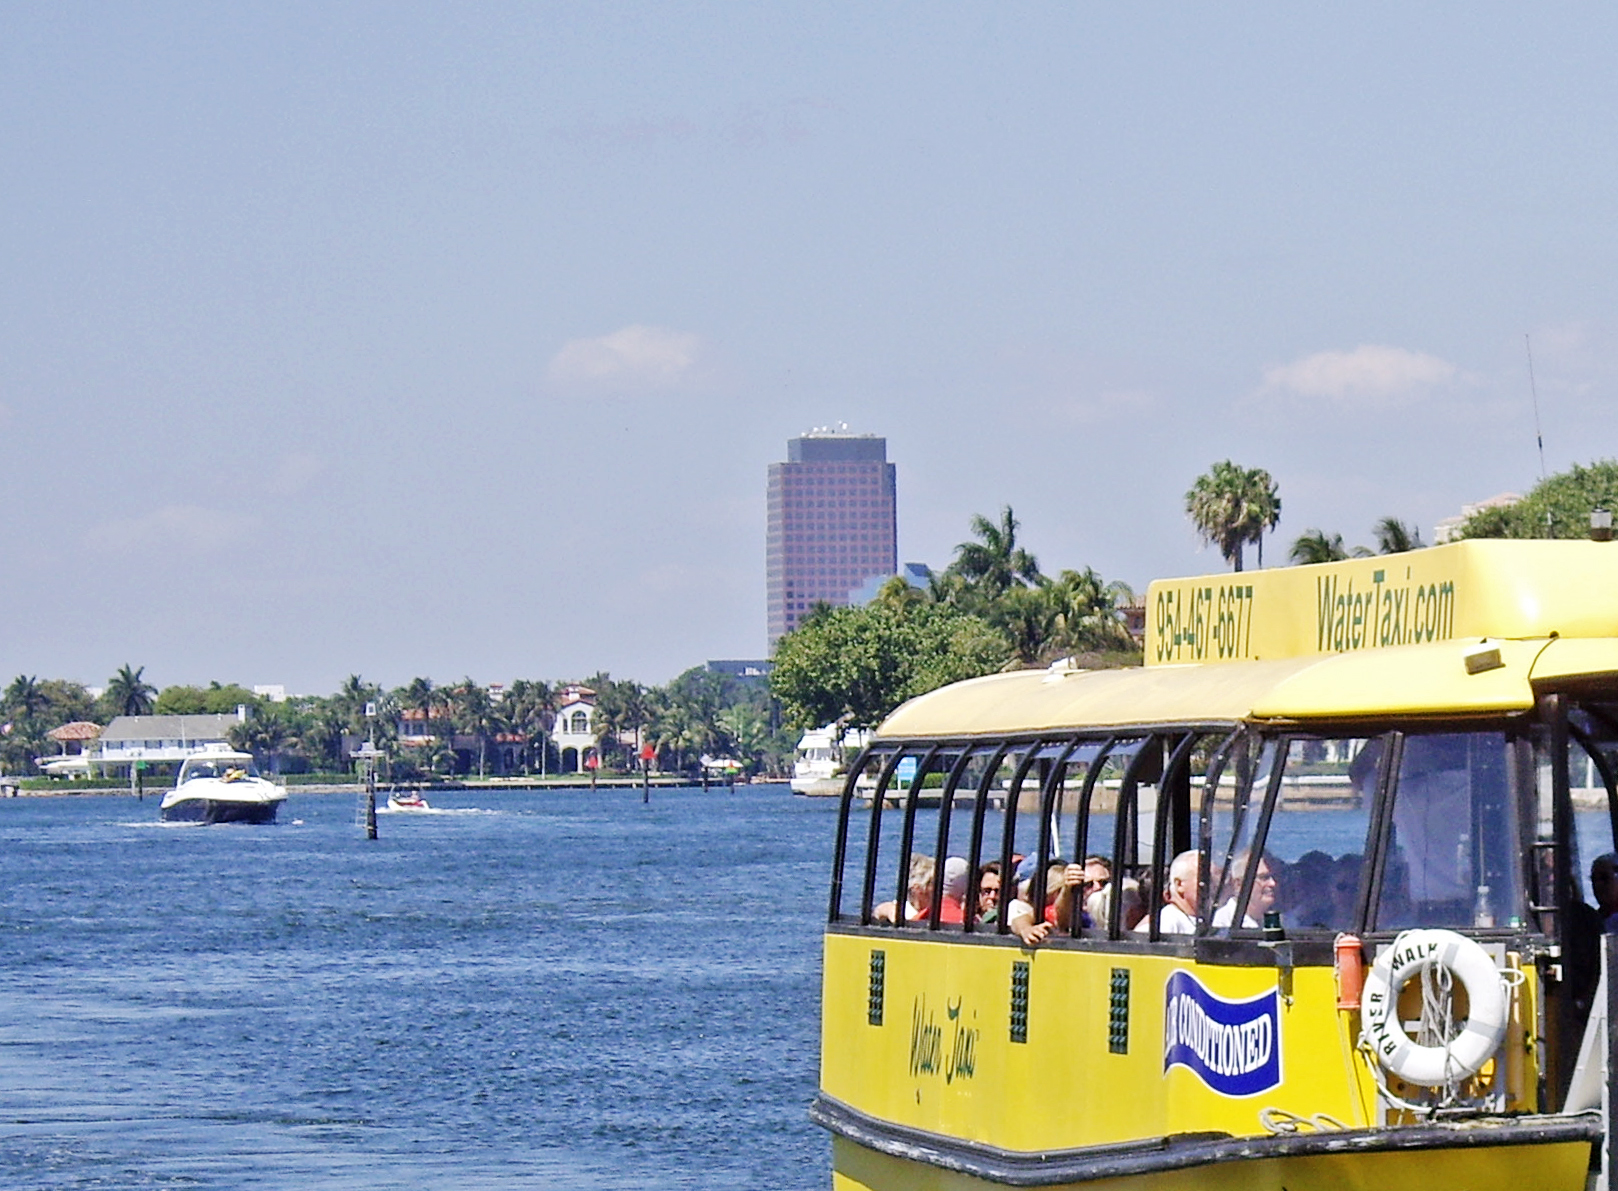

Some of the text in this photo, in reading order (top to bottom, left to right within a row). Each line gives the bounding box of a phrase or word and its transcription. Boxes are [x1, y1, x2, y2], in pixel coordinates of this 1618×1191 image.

[1157, 585, 1253, 661] 954-467-6677
[1317, 566, 1454, 652] WaterTaxi.com
[1179, 992, 1272, 1076] CONDITIONED
[1369, 943, 1438, 1055] RIVER WALK
